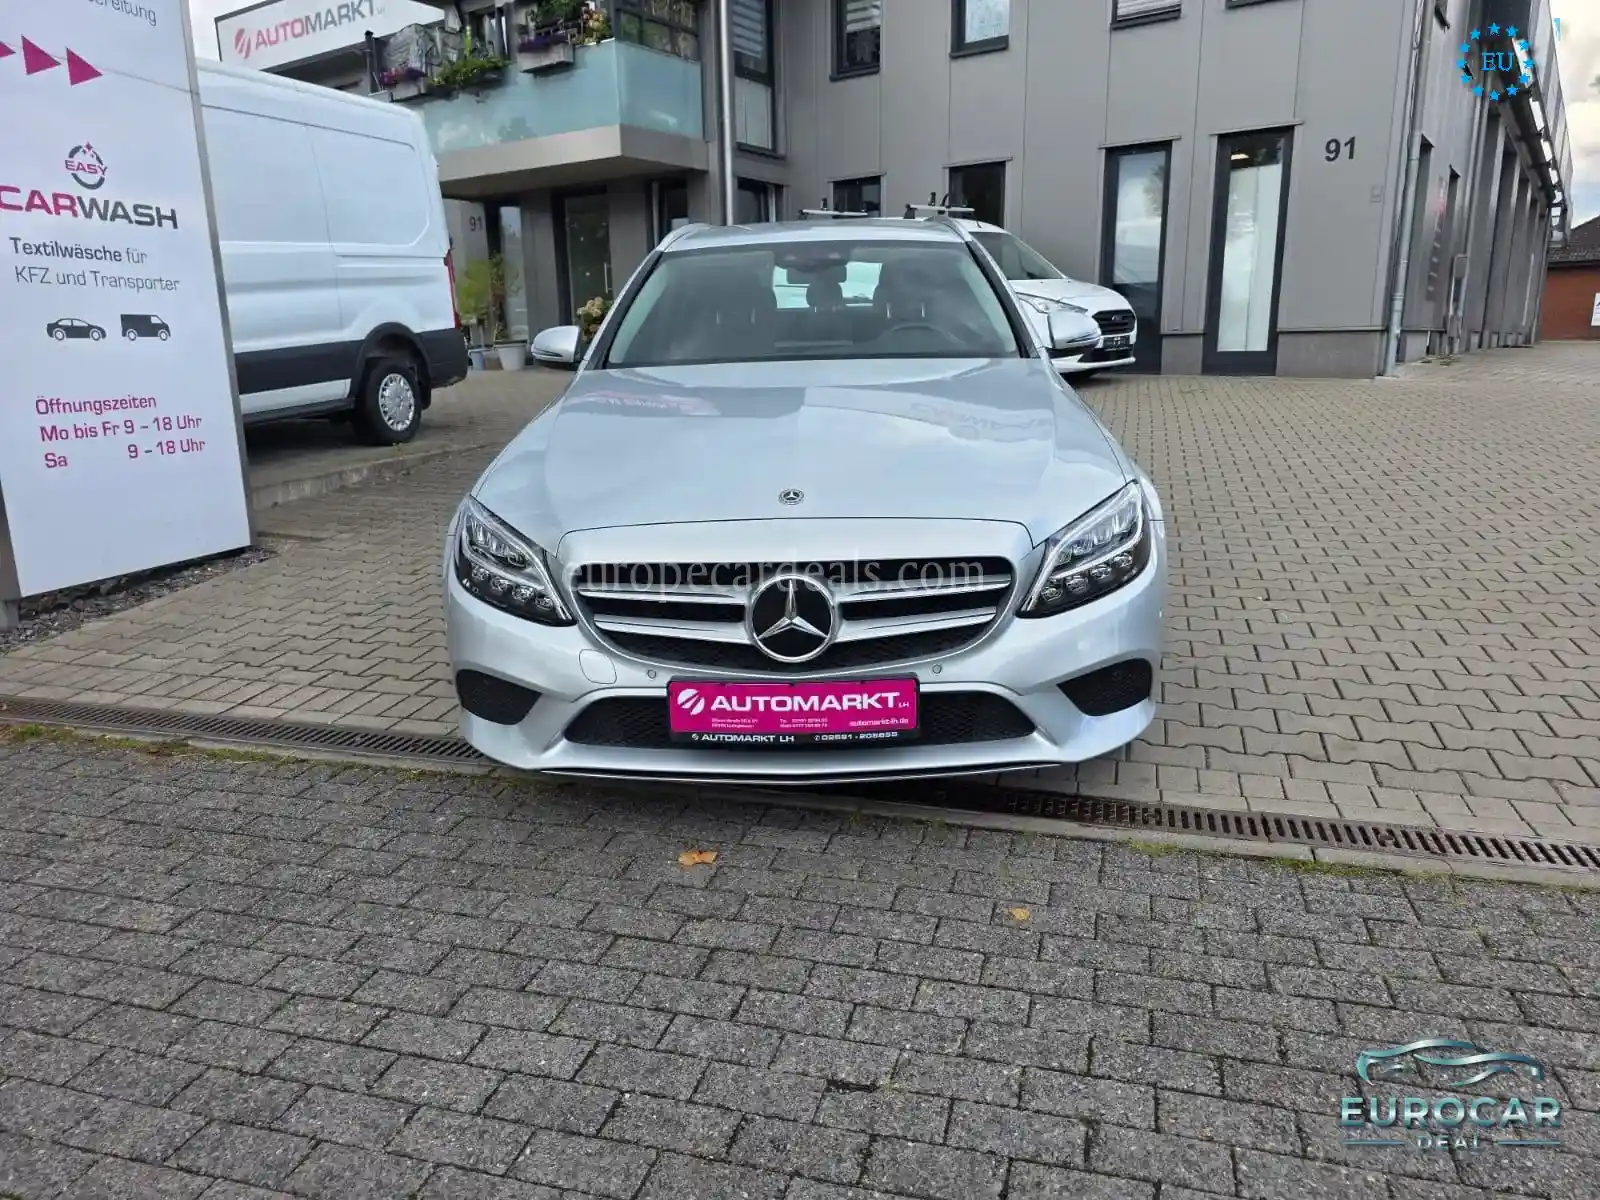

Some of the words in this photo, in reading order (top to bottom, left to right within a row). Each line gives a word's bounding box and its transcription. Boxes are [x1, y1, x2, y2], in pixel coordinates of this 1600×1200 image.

[255, 0, 375, 50] AUTOMARKT
[1324, 136, 1357, 162] 91
[65, 160, 107, 176] EASY
[0, 185, 178, 229] CARWASH
[469, 216, 483, 231] 91
[9, 237, 122, 263] Textilwäsche
[126, 247, 148, 264] für
[15, 266, 51, 284] KFZ
[56, 271, 87, 286] und
[90, 271, 181, 293] Transporter
[35, 395, 157, 415] Öffnungszeiten
[40, 425, 69, 442] Mo
[74, 423, 98, 440] bis
[102, 421, 119, 437] Fr
[124, 419, 135, 435] 9
[153, 416, 172, 431] 18
[177, 415, 202, 430] Uhr
[44, 453, 68, 468] Sa
[128, 444, 138, 459] 9
[156, 440, 175, 456] 18
[180, 438, 206, 453] Uhr
[710, 692, 900, 712] AUTOMARKT
[701, 734, 776, 743] AUTOMARKT
